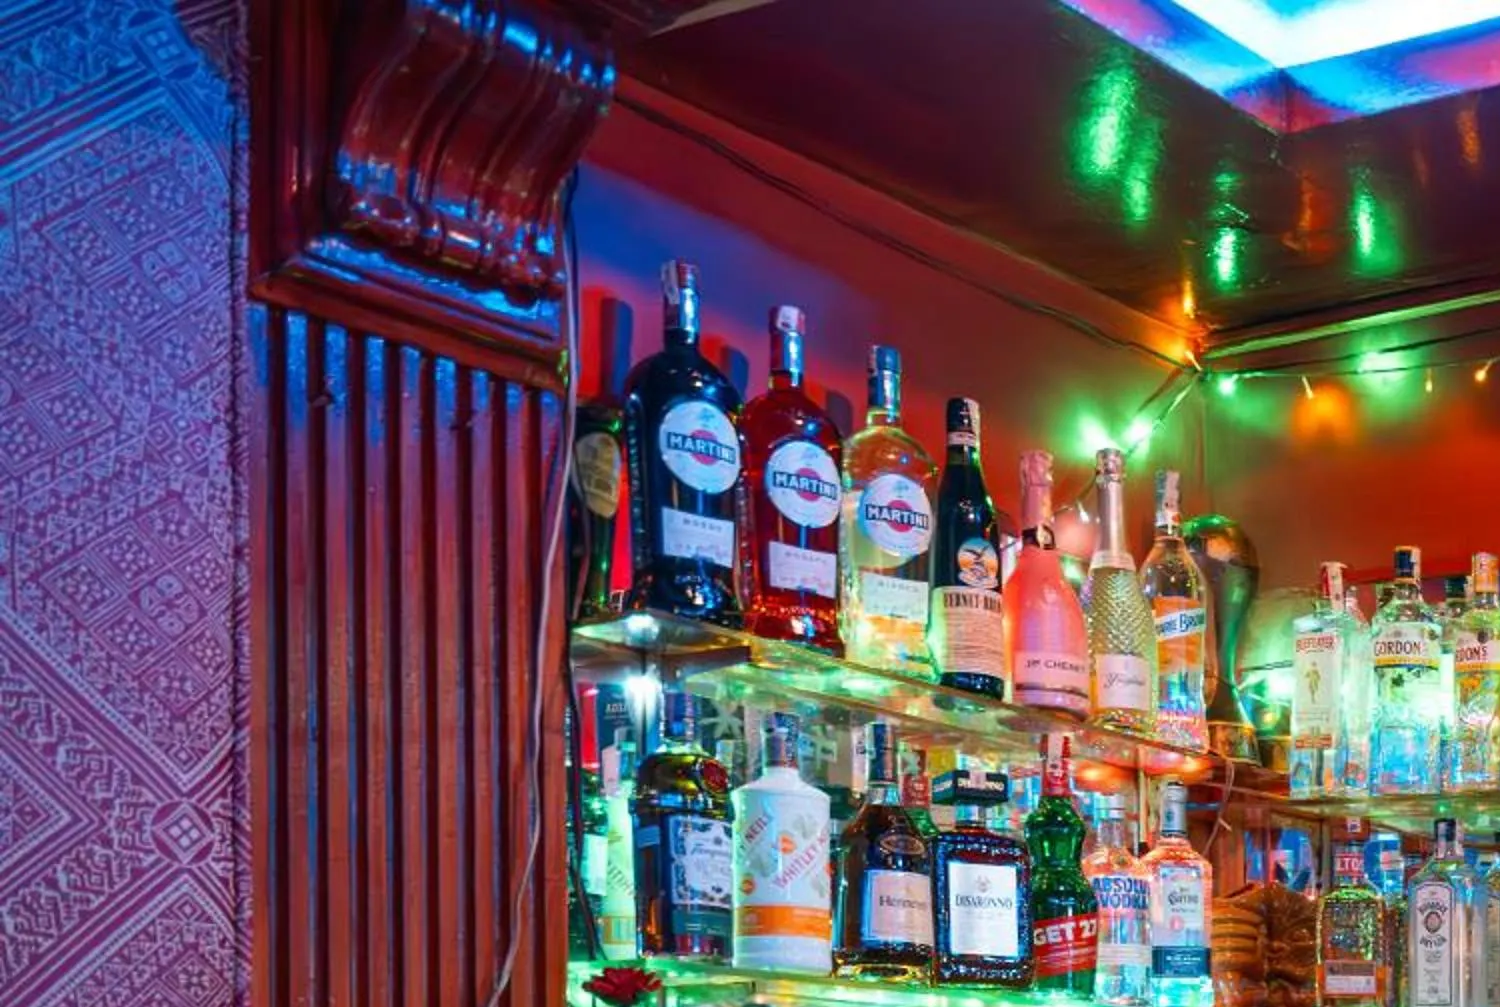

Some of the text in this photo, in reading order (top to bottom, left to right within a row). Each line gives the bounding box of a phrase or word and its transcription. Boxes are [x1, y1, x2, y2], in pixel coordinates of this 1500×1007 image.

[668, 432, 736, 464] MARTINI
[774, 472, 837, 500] MARTINI
[866, 505, 929, 530] MARTINI
[1033, 921, 1076, 946] GET
